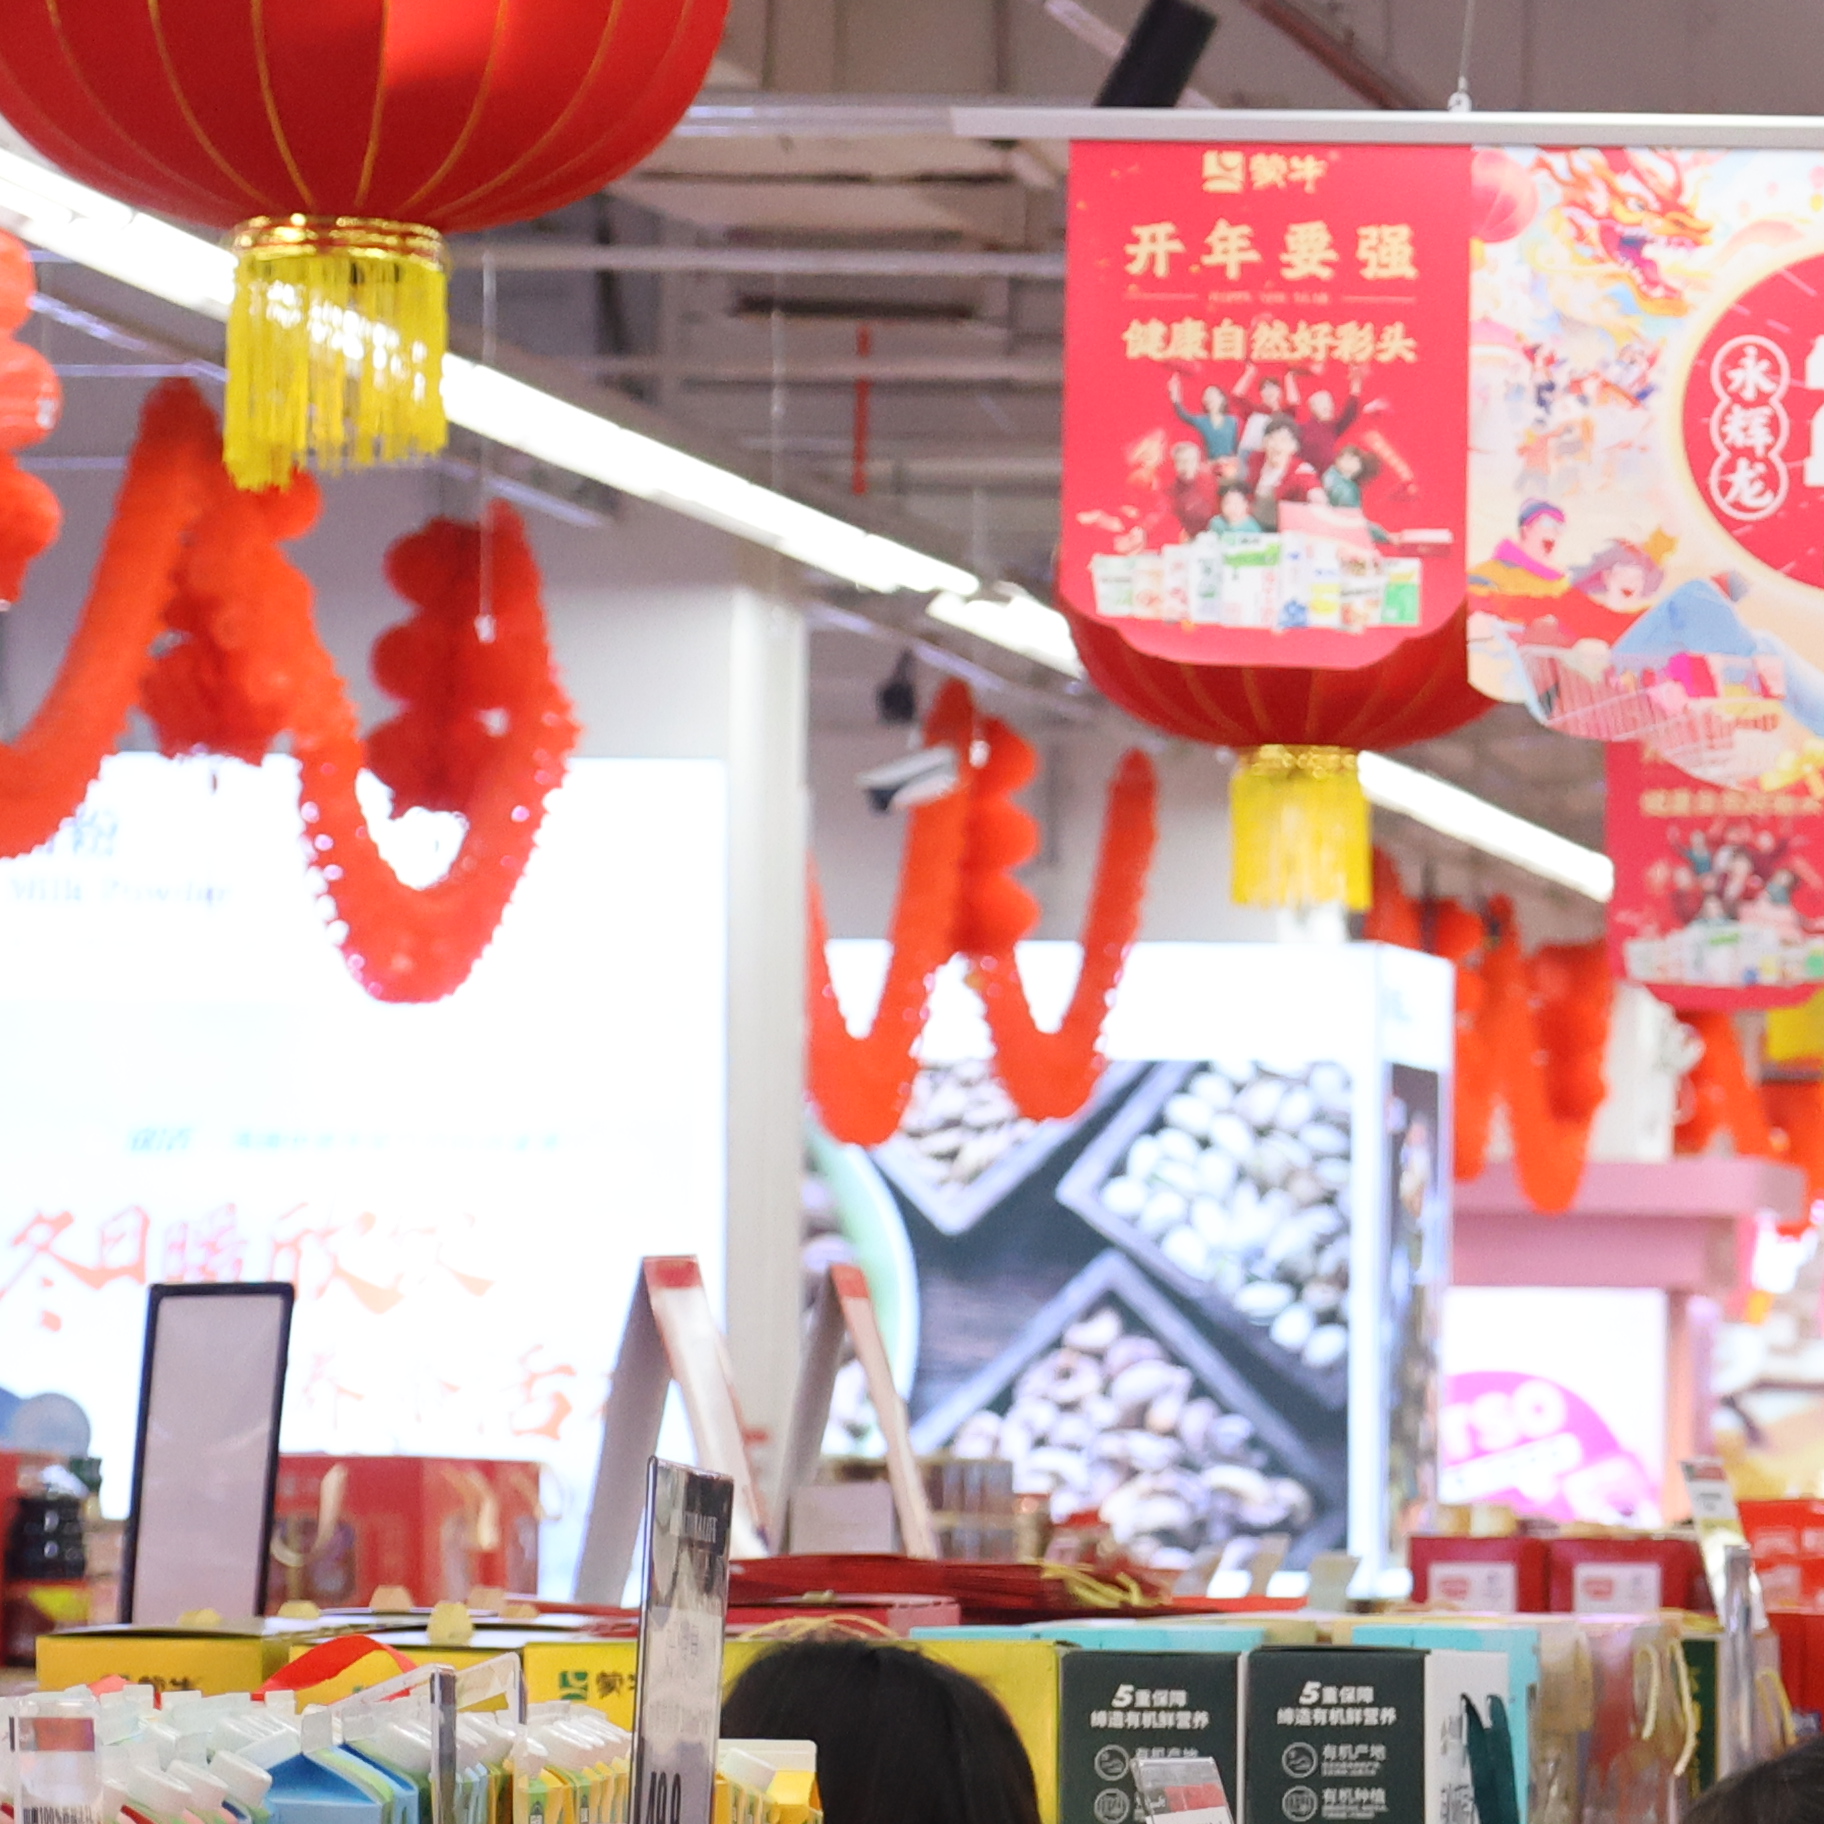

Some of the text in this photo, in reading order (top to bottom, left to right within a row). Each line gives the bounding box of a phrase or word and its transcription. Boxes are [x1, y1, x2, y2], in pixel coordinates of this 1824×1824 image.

[1251, 152, 1328, 195] 蒙牛
[1123, 221, 1418, 281] 开年要强
[1122, 318, 1418, 364] 健康自然好彩头
[1722, 347, 1777, 508] 永辉龙
[1321, 1743, 1387, 1762] 有机产地
